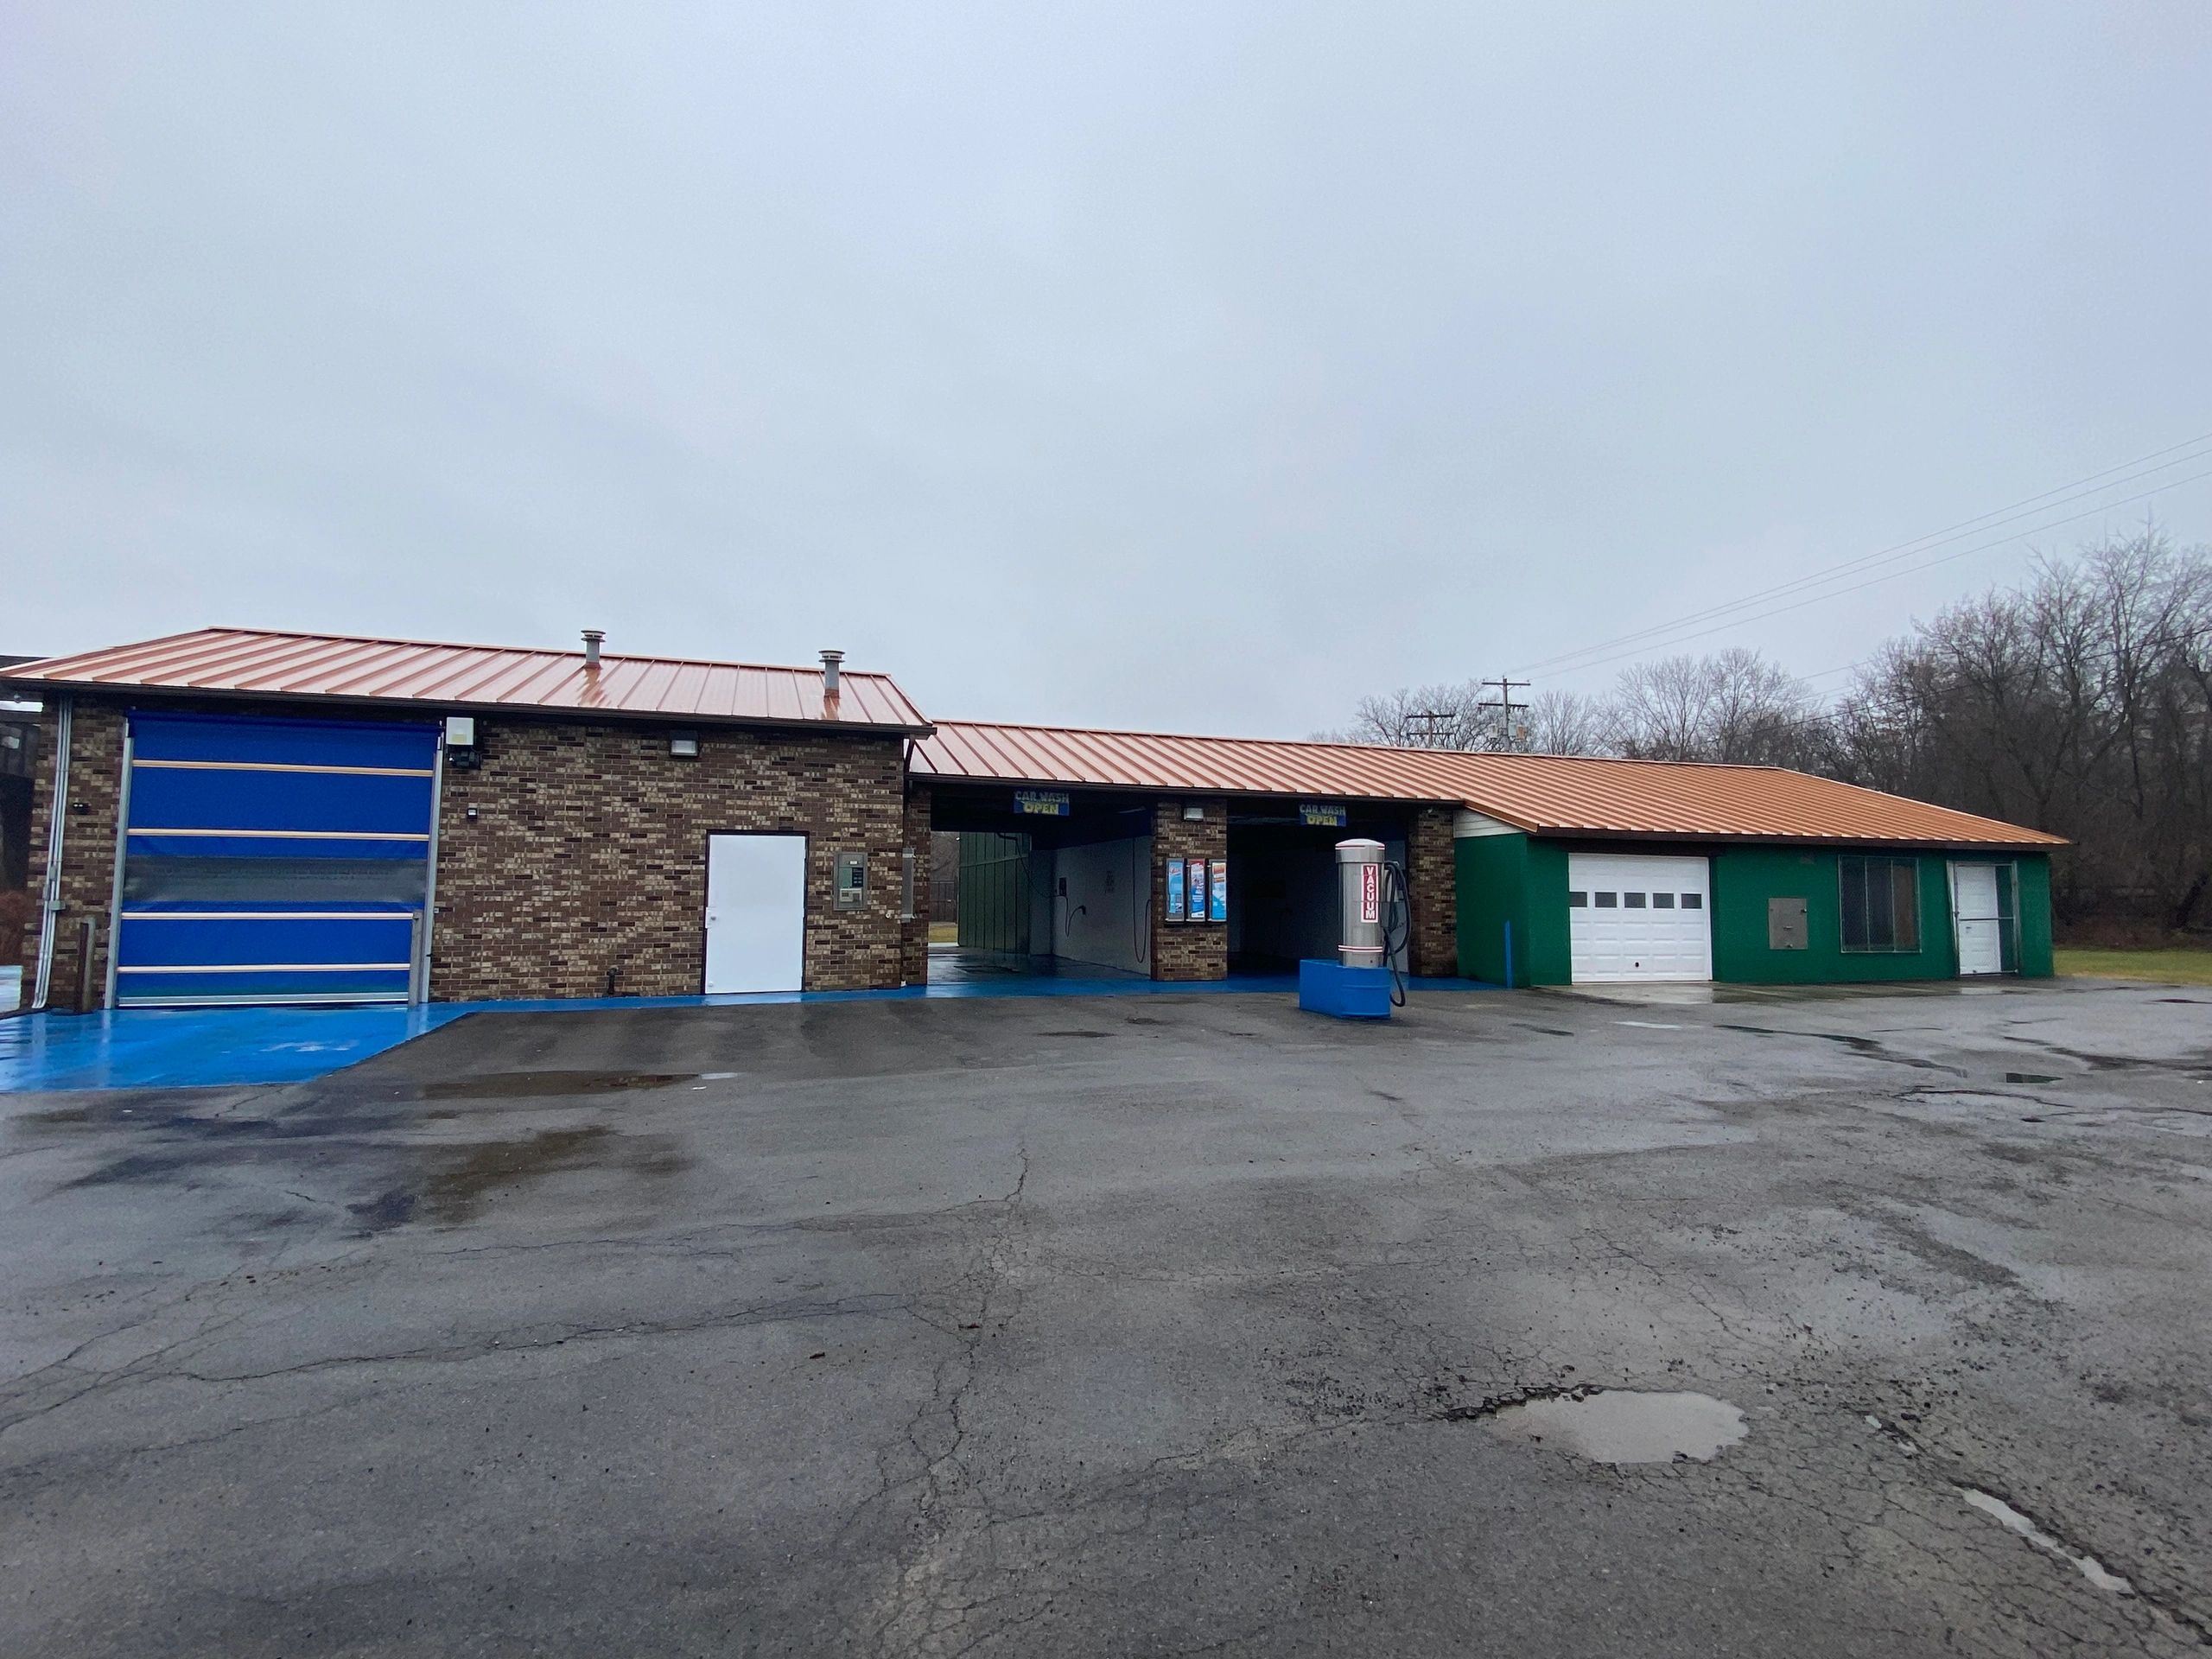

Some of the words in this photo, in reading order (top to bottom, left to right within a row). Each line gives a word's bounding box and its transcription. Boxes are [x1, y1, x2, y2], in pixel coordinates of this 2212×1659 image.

[1014, 791, 1037, 801] CAR
[1039, 791, 1069, 803] WASH
[1023, 802, 1059, 815] OPEN
[1299, 804, 1319, 813] CAR
[1319, 804, 1346, 816] WASH
[1306, 815, 1338, 826] OPEN
[1365, 866, 1376, 919] VACUUM
